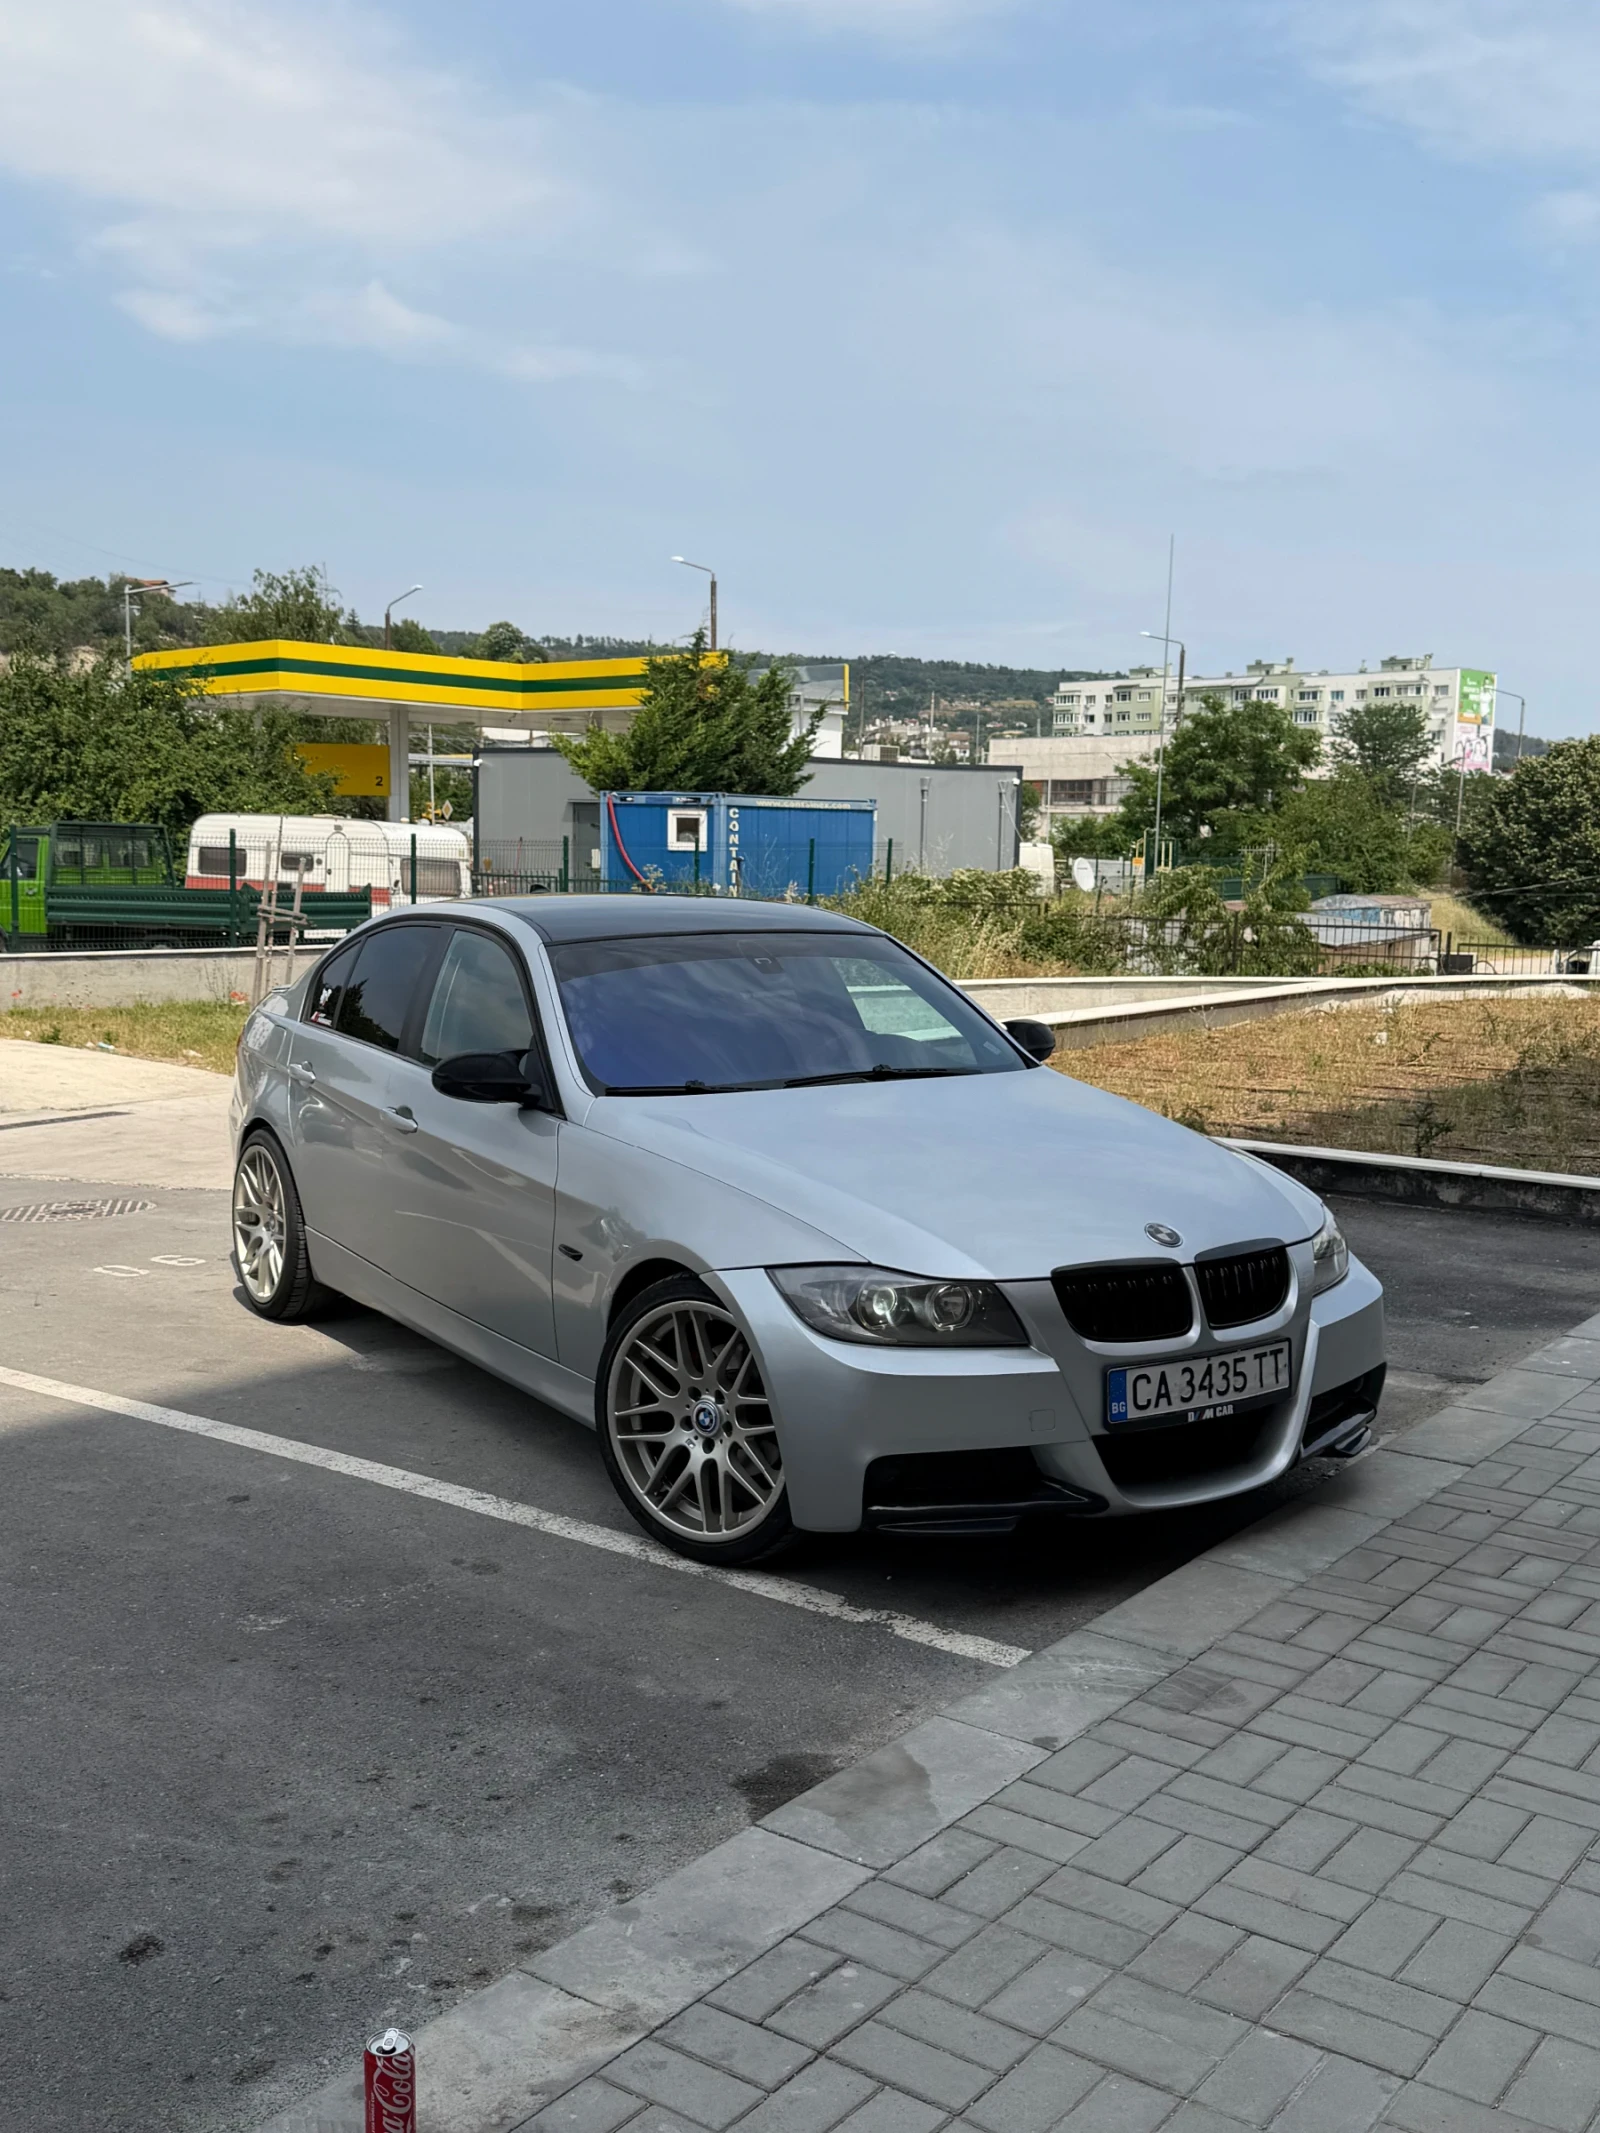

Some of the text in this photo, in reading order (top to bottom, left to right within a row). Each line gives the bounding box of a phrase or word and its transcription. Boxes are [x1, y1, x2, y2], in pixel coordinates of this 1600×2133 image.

[375, 776, 383, 786] 2
[1132, 1348, 1284, 1410] CA 3435 TT
[1111, 1401, 1126, 1415] BG
[1216, 1404, 1234, 1417] CAR
